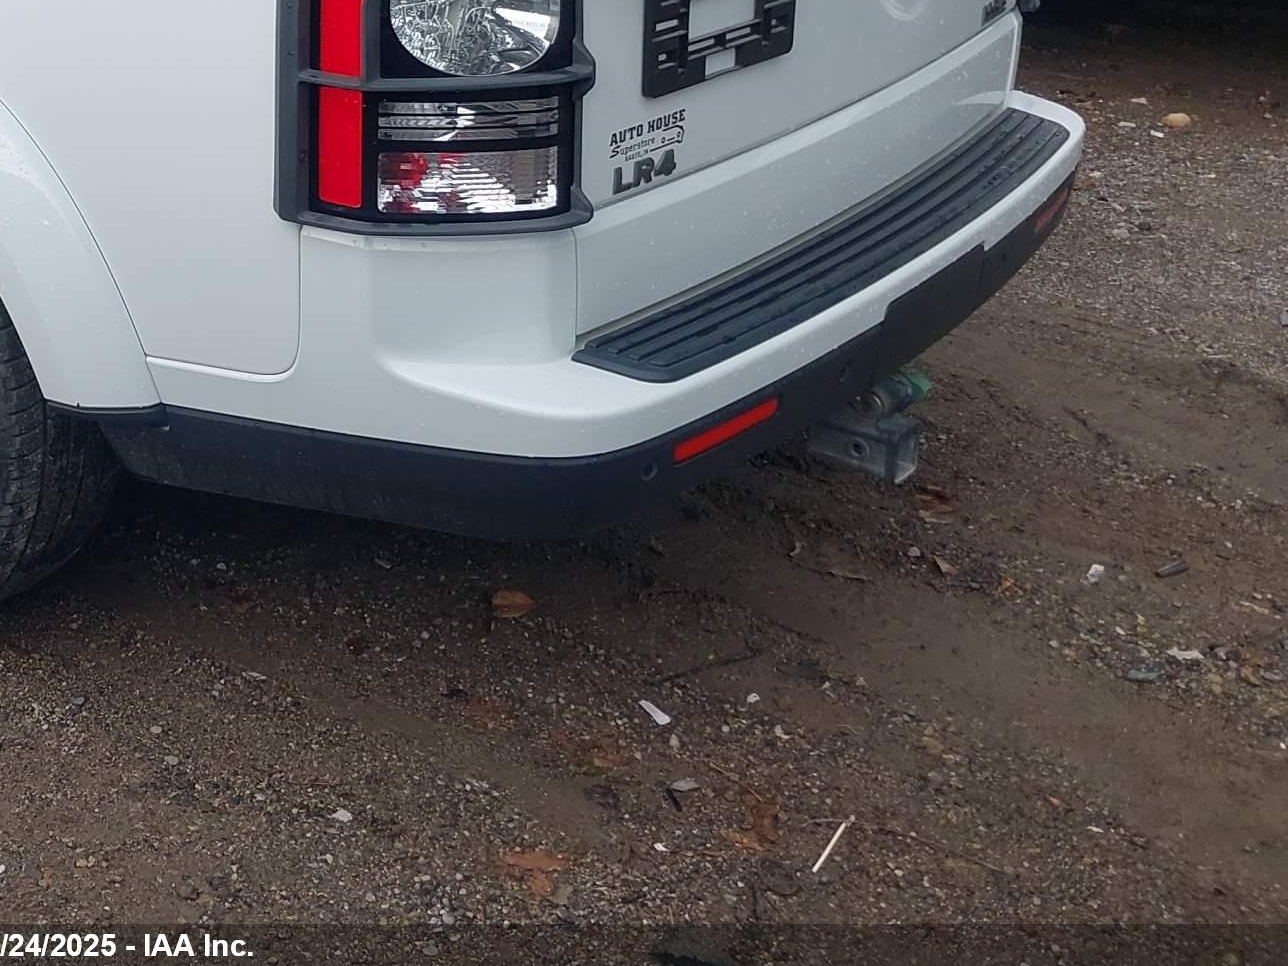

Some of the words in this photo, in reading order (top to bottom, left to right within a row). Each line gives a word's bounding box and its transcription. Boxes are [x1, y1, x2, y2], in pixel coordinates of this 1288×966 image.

[608, 123, 644, 147] AUTO
[646, 108, 686, 134] HOUSE
[609, 136, 656, 159] Superstore
[612, 149, 677, 195] LR4
